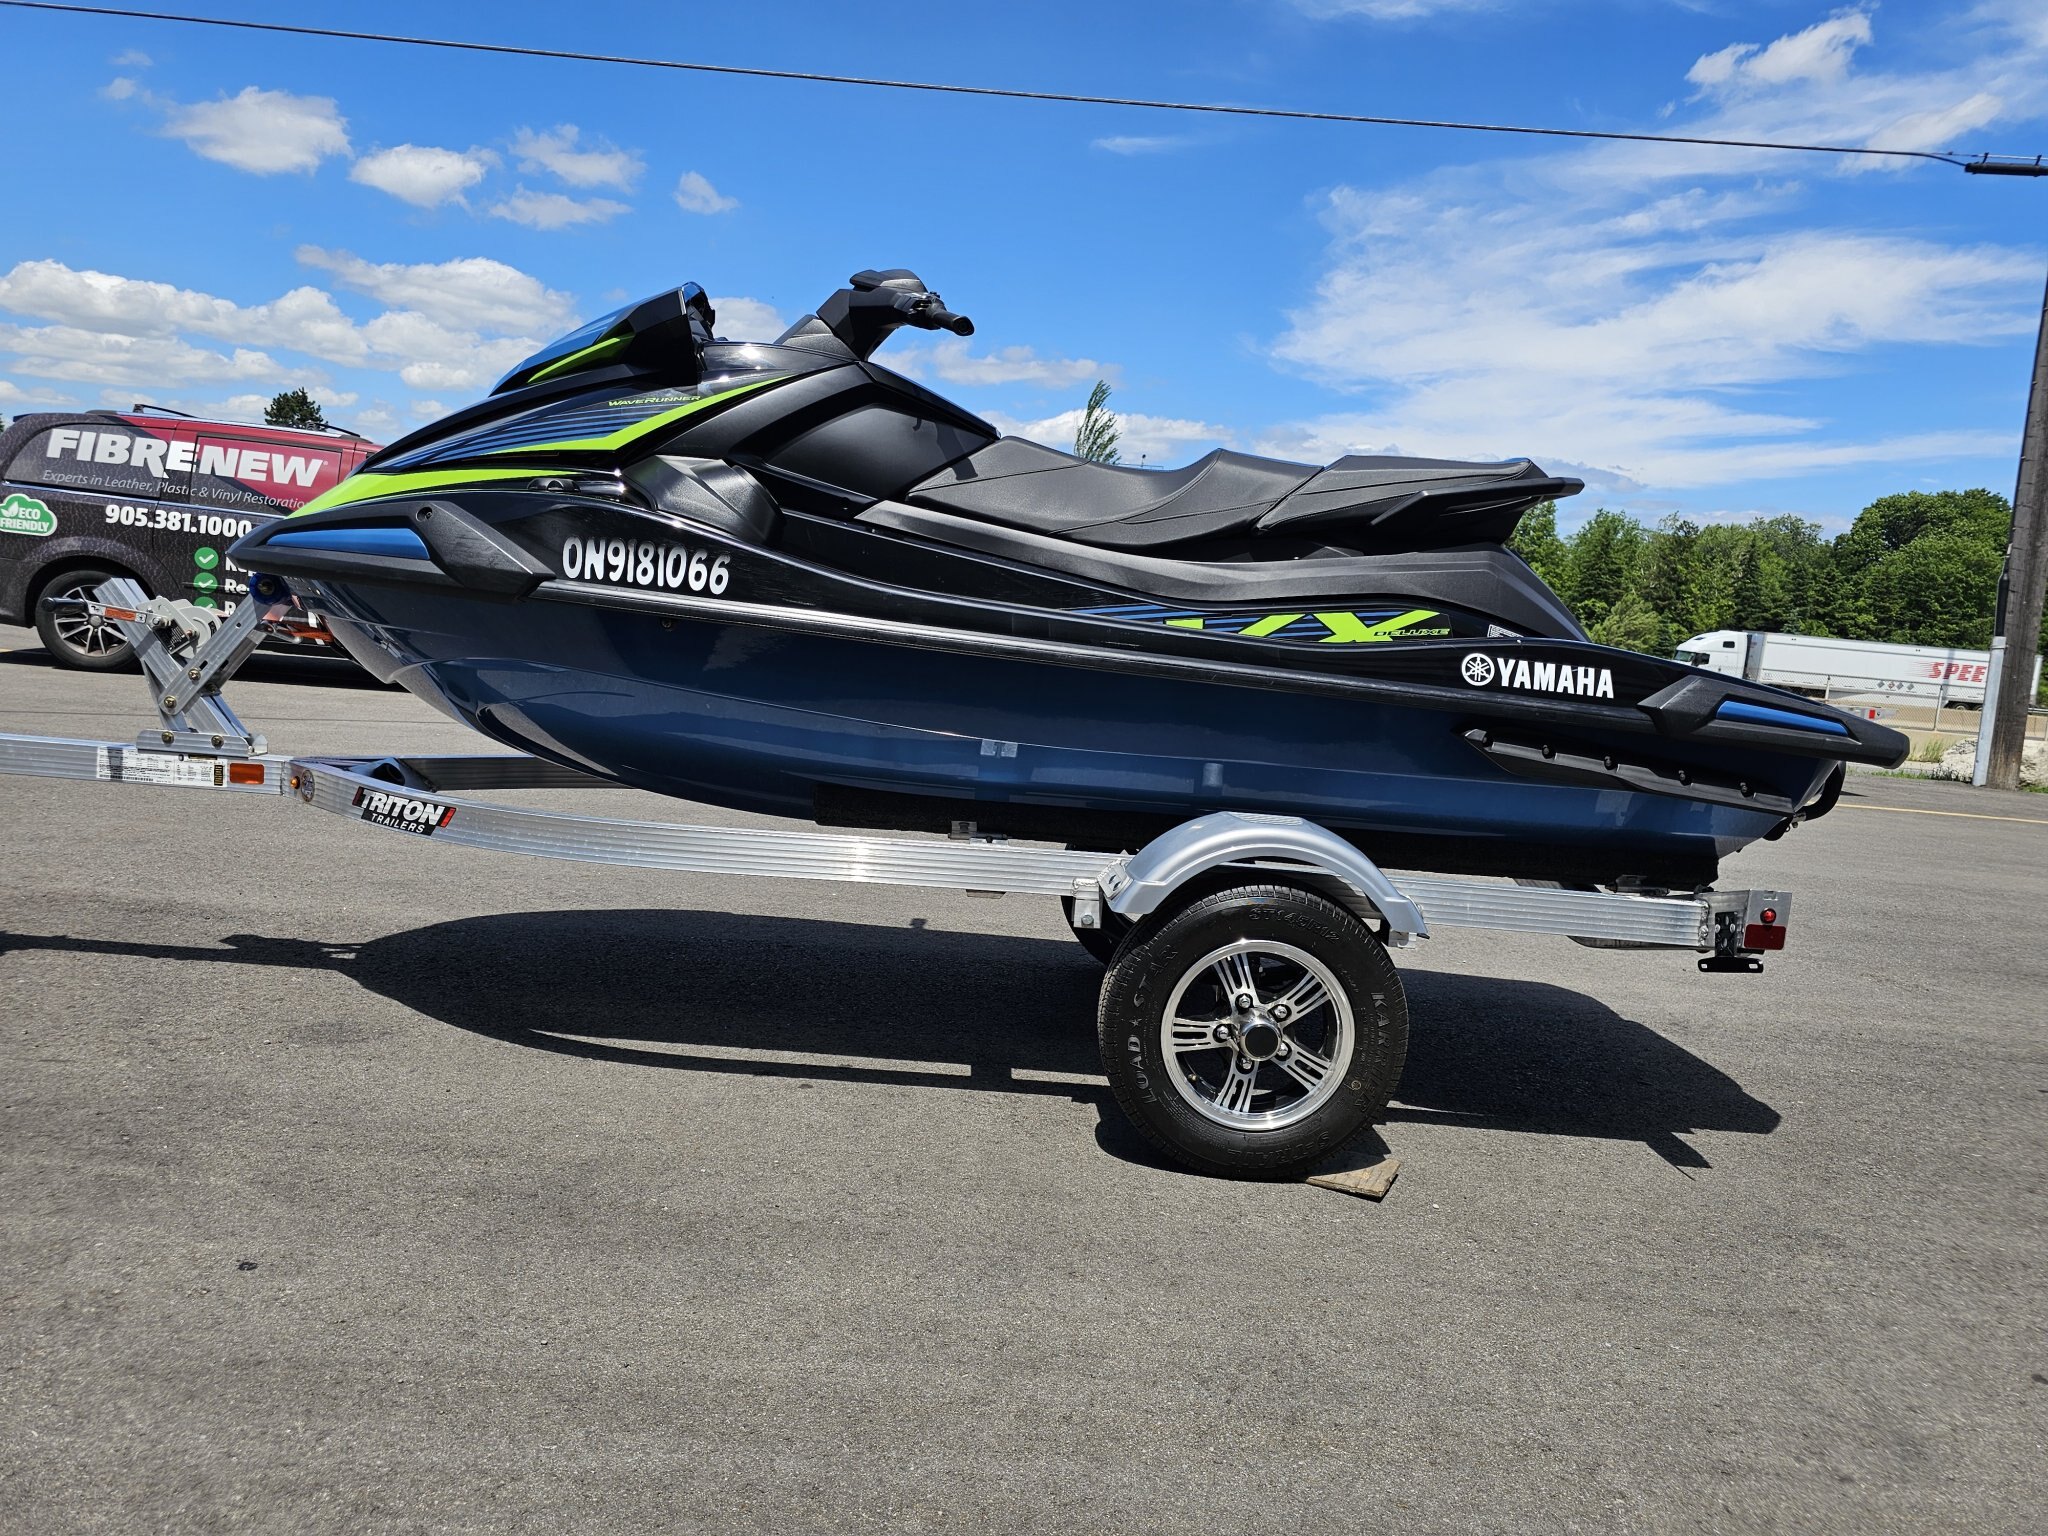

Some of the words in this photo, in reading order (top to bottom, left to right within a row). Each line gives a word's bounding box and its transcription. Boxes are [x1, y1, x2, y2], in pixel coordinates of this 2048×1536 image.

[46, 428, 322, 488] FIBRENEW
[42, 469, 88, 485] Experts
[90, 474, 103, 486] in
[104, 477, 153, 493] Leather,
[157, 482, 197, 496] Plastic
[198, 487, 209, 498] &
[212, 488, 242, 503] Vinyl
[243, 493, 305, 509] Restoratio
[0, 517, 49, 532] FRIENDLY
[18, 507, 41, 520] ECO
[105, 504, 252, 538] 905.381.1000
[562, 536, 732, 595] ON9181066
[1373, 628, 1450, 637] DELUXE
[1497, 657, 1614, 699] YAMAHA
[1927, 662, 1987, 683] SPEE
[360, 788, 446, 827] TRITON
[371, 813, 425, 834] TRAILERS
